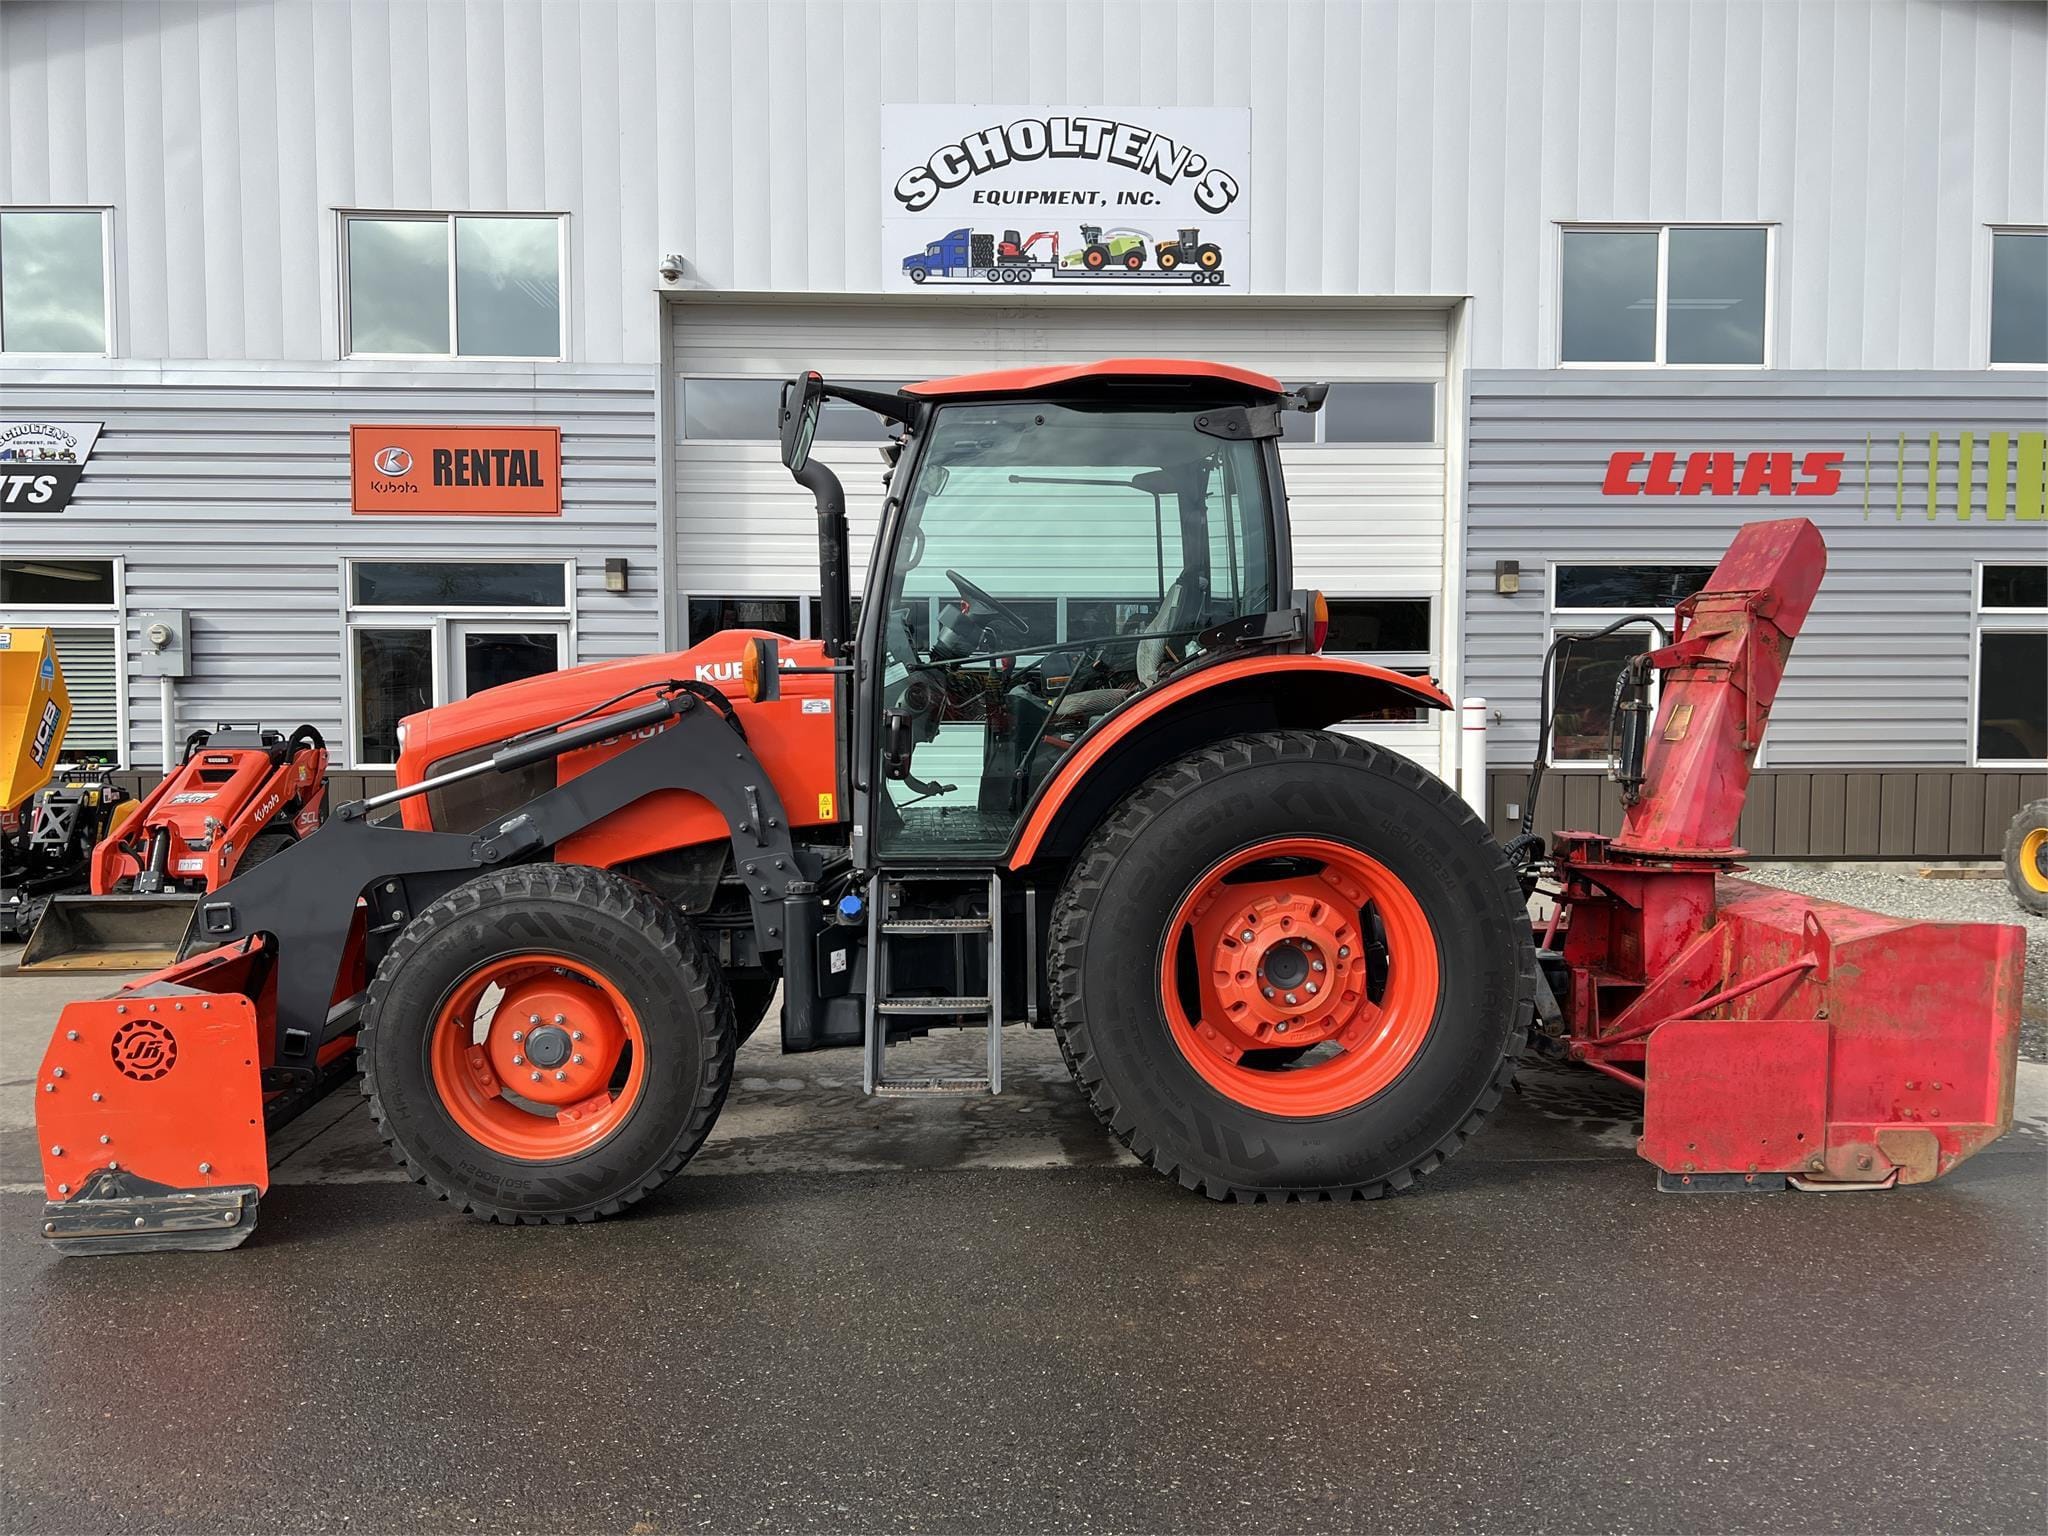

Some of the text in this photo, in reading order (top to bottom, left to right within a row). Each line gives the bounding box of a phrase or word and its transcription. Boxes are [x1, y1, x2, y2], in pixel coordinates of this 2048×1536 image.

[894, 116, 1239, 215] SCHOLTEN'S
[972, 190, 1161, 207] EQUIPMENT, INC.
[371, 481, 418, 494] Kubota
[433, 448, 544, 488] RENTAL
[1602, 451, 1845, 496] CLAAS
[33, 700, 57, 762] JCB
[253, 794, 280, 822] Kubota
[300, 811, 318, 824] SCL
[1380, 819, 1457, 893] 480/80R34
